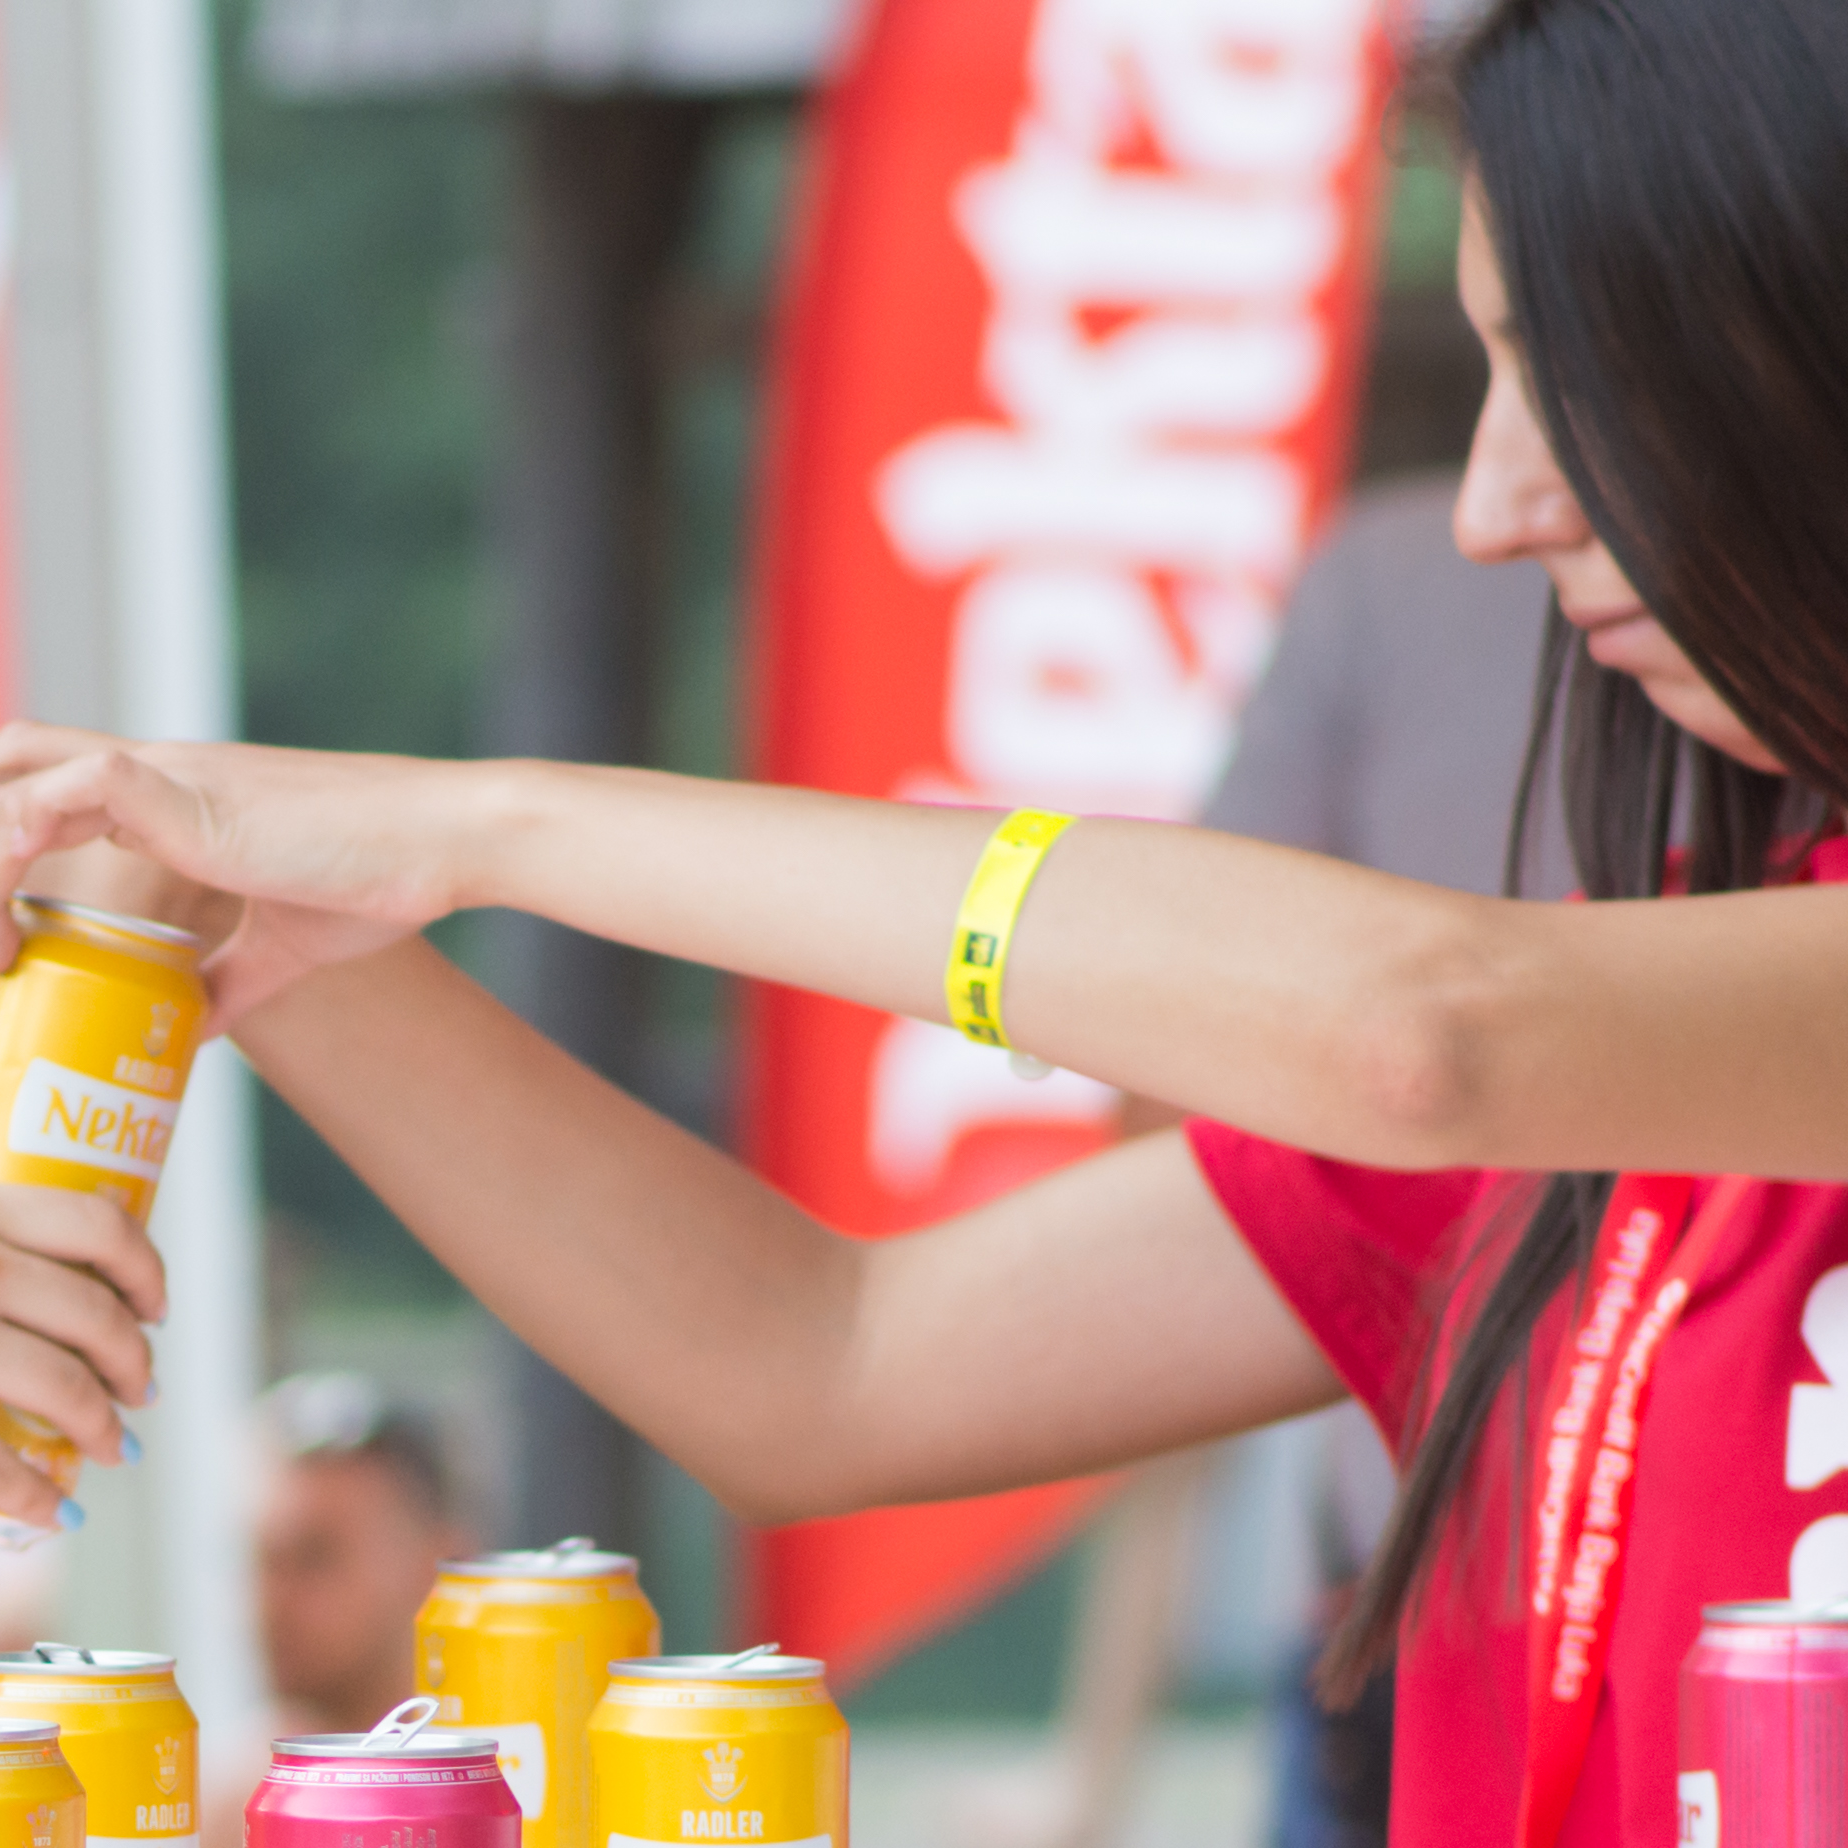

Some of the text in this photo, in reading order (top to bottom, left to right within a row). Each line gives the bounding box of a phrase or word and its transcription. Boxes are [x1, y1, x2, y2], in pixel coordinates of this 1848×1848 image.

[135, 1803, 190, 1832] RADLER
[681, 1809, 764, 1837] RADLER
[33, 1837, 51, 1847] 1873
